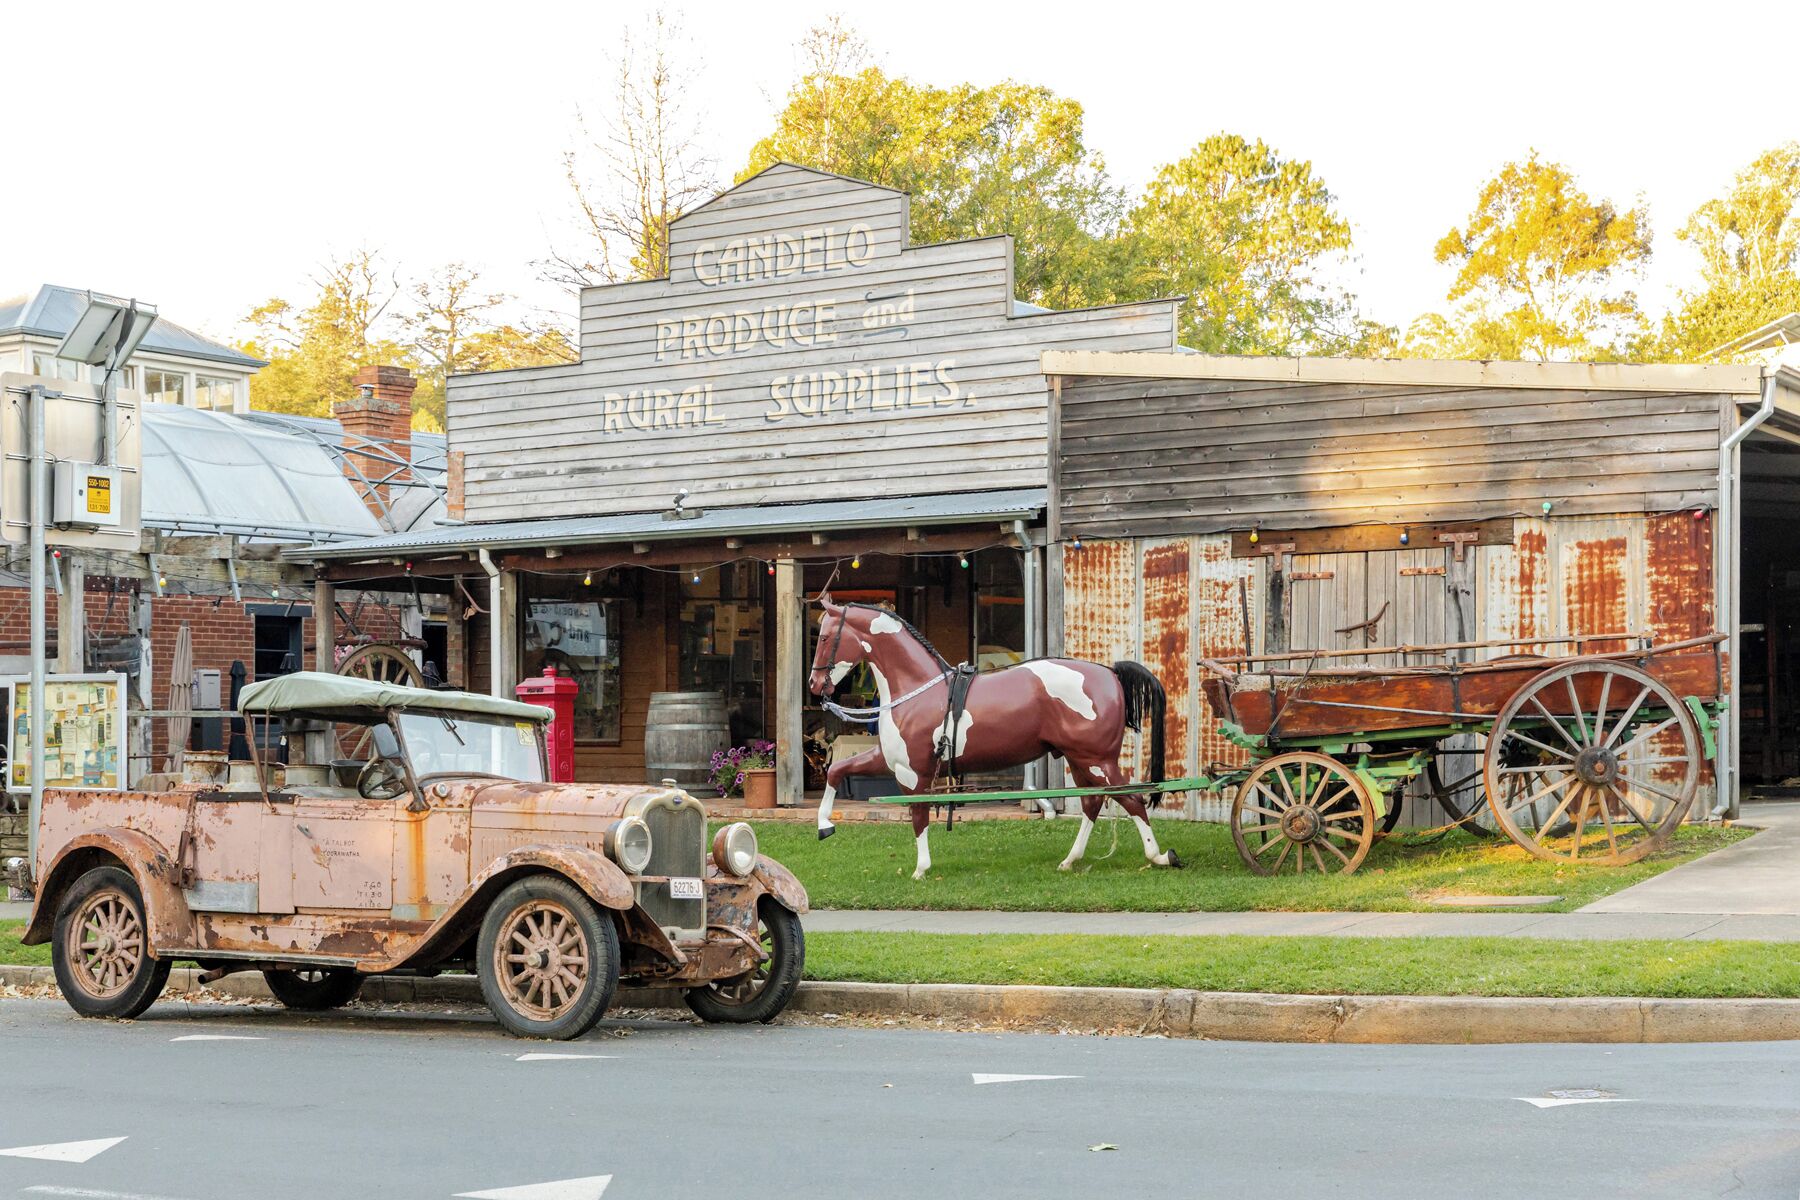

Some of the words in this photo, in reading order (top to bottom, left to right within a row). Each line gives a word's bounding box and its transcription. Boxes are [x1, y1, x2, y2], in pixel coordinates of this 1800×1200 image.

[693, 222, 877, 287] CANDELO
[655, 298, 838, 362] PRODUCE
[862, 288, 915, 330] and
[602, 382, 727, 435] RURAL
[765, 358, 978, 423] SUPPLIES.
